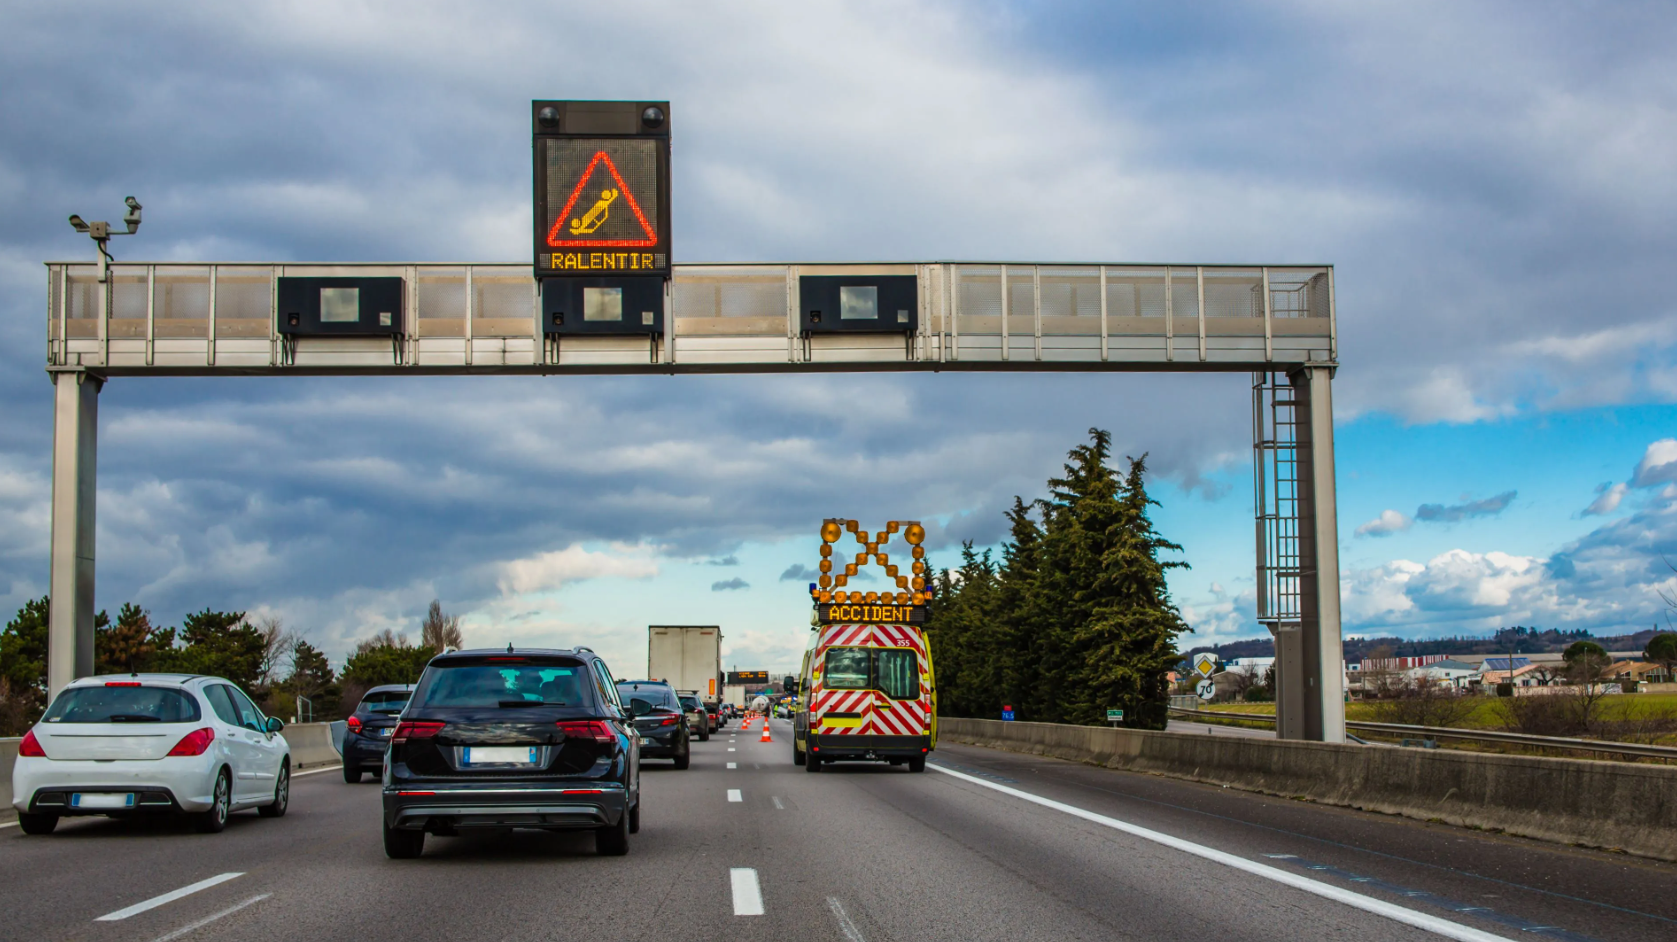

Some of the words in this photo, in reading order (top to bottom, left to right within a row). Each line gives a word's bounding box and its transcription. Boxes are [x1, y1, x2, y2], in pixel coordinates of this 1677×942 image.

[551, 252, 654, 270] RALENTIR
[829, 605, 914, 621] ACCIDENT
[896, 639, 910, 647] 355
[1200, 685, 1212, 694] 70
